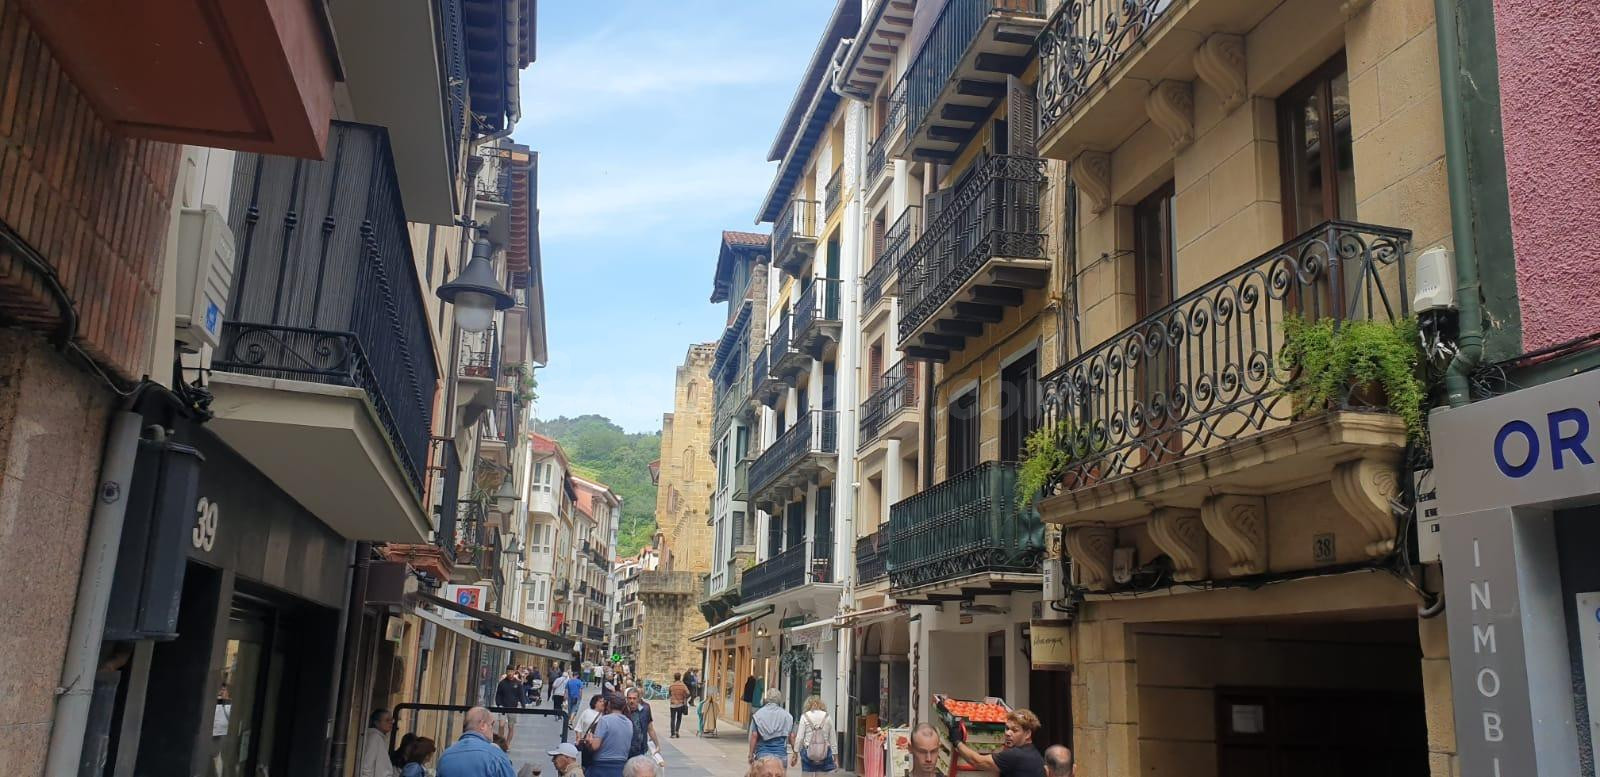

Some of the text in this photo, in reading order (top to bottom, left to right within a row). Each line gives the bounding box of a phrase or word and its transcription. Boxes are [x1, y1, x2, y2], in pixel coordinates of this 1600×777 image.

[1493, 400, 1600, 479] OR
[192, 496, 219, 552] 39
[1316, 537, 1332, 558] 38
[1470, 537, 1505, 777] INMOBI
